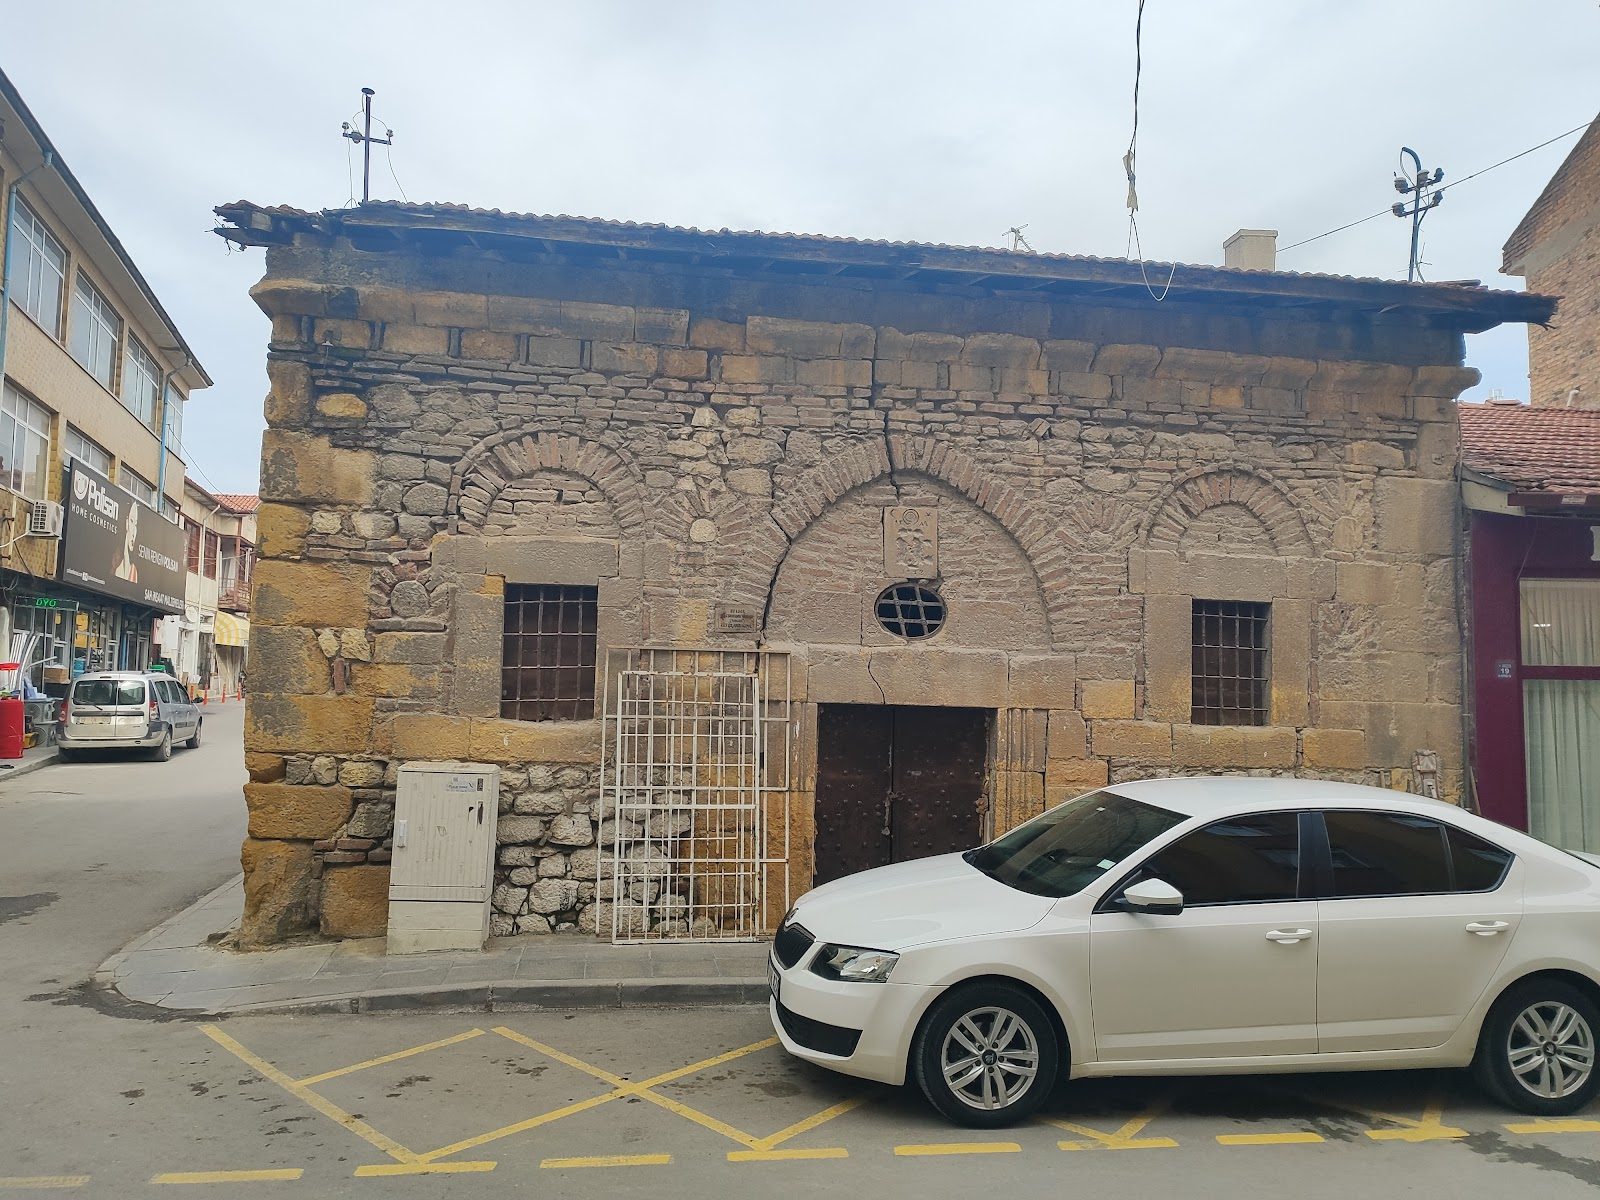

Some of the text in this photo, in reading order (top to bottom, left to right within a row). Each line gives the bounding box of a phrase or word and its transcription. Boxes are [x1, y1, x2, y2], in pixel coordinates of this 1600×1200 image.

[87, 478, 119, 521] Polisan
[71, 503, 118, 535] HOME COSMETICS
